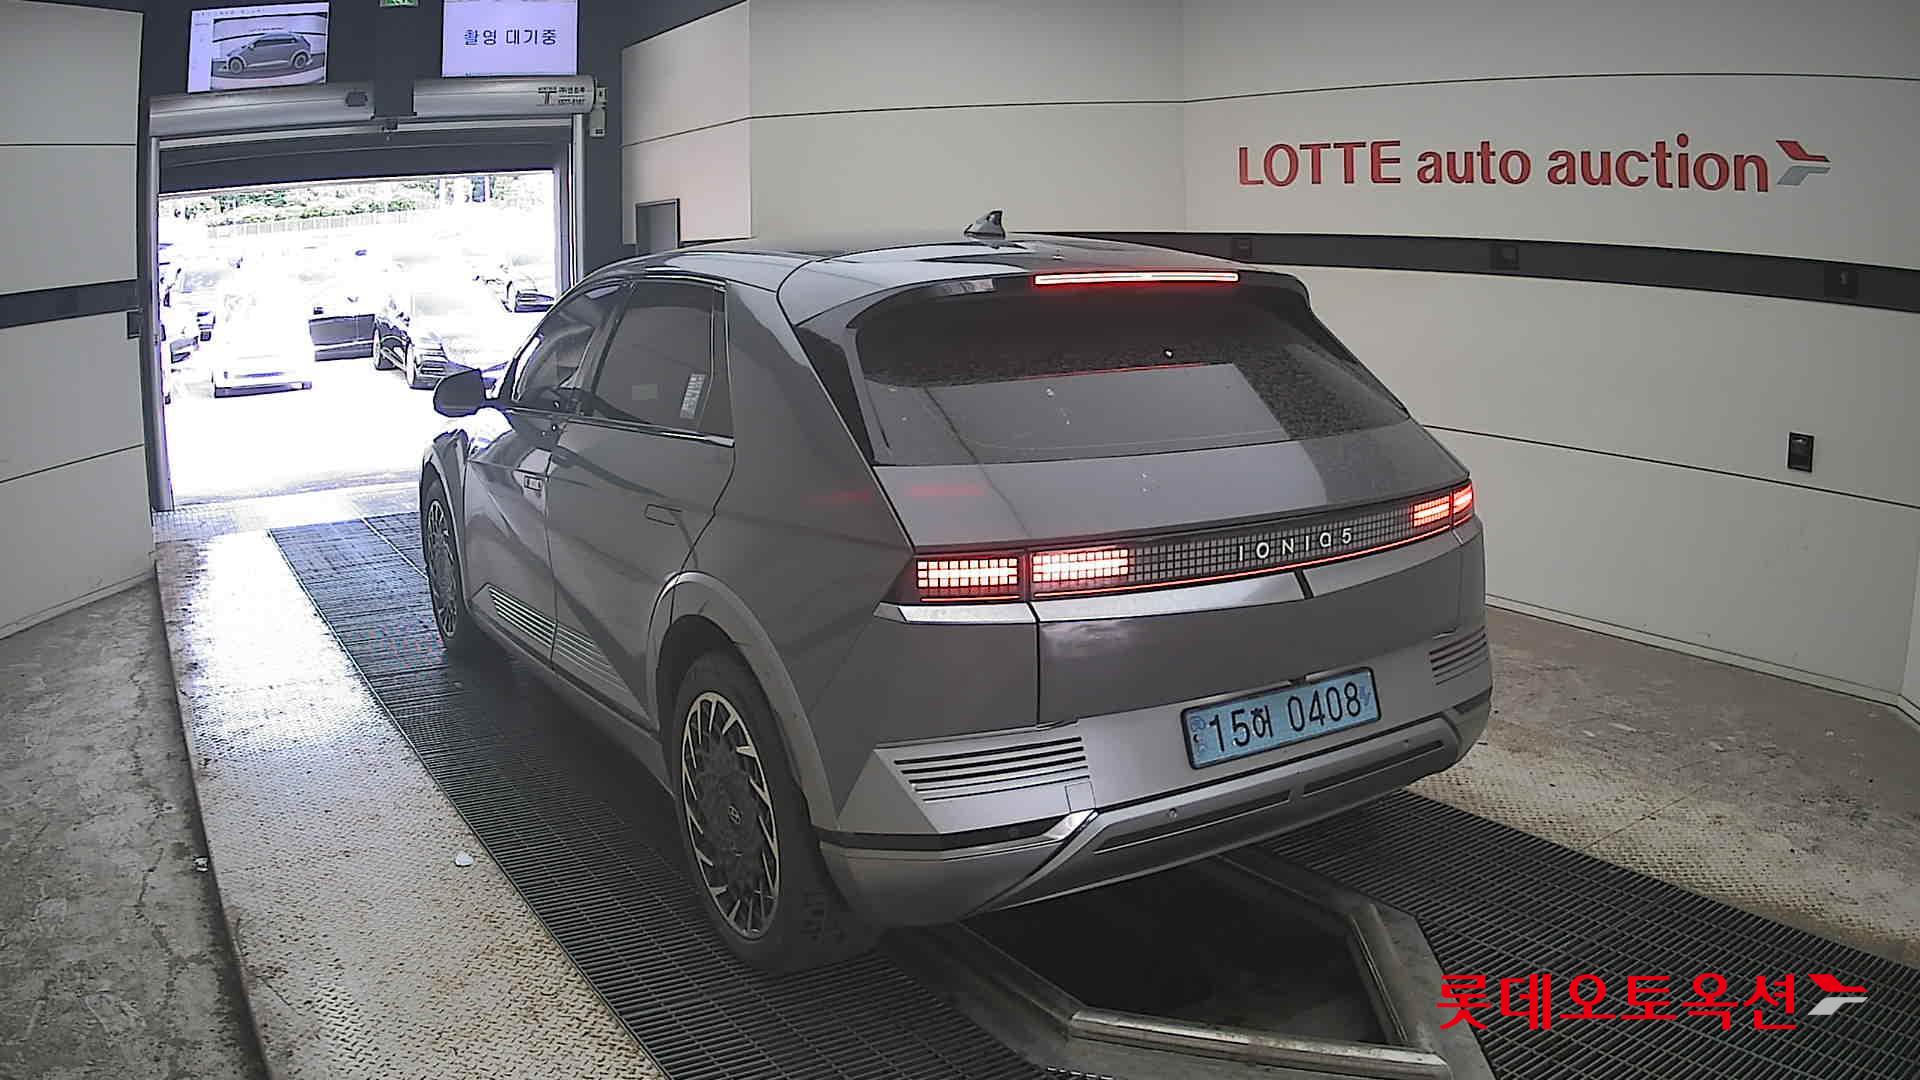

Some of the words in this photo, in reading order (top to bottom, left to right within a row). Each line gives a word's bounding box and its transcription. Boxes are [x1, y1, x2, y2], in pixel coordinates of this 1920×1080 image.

[463, 28, 497, 46] 촬영
[505, 28, 556, 46] 대기중
[1238, 140, 1401, 187] LOTTE
[1417, 140, 1532, 186] auto
[1547, 133, 1770, 193] auction
[1208, 704, 1274, 753] 15허
[1286, 681, 1362, 733] 0408
